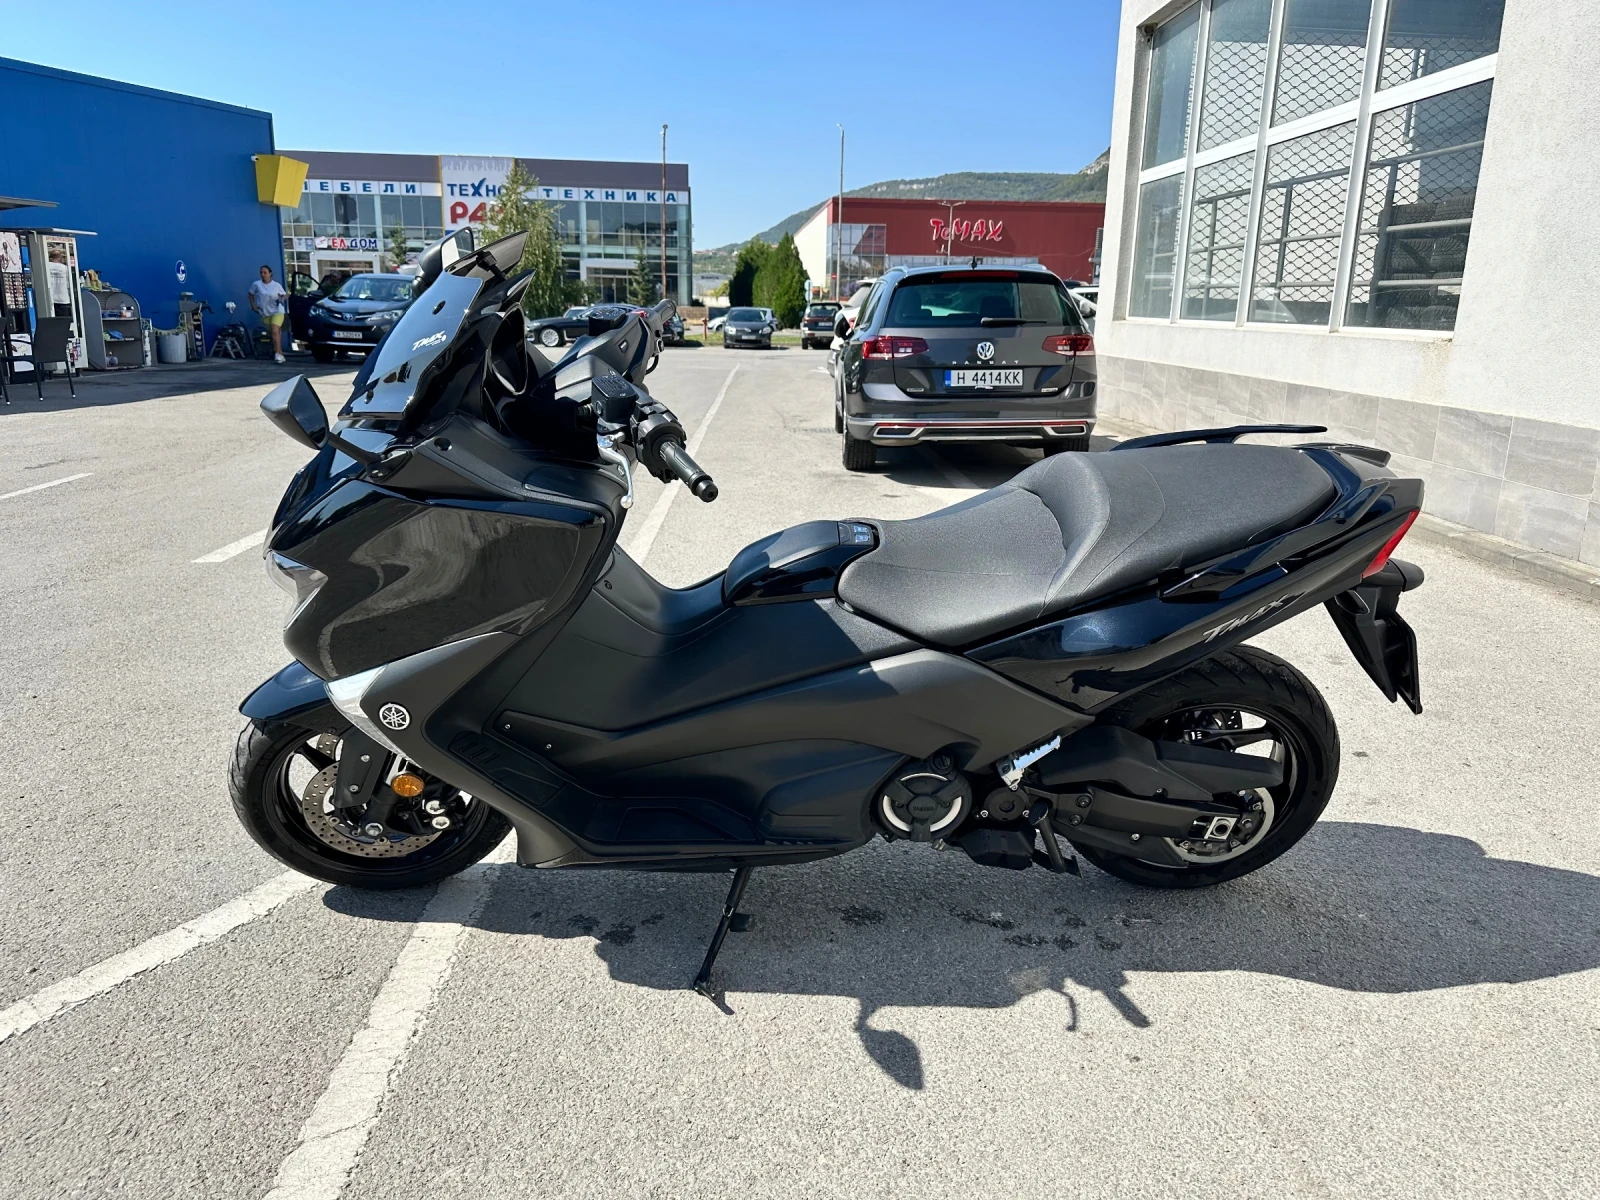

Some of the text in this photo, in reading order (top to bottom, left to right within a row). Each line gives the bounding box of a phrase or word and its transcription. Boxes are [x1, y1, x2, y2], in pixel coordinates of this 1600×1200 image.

[543, 188, 677, 202] ТЕХНИКА
[331, 238, 378, 249] ЕЛ ДОМ
[972, 372, 1020, 384] 4414KK
[1203, 593, 1288, 643] TMAX
